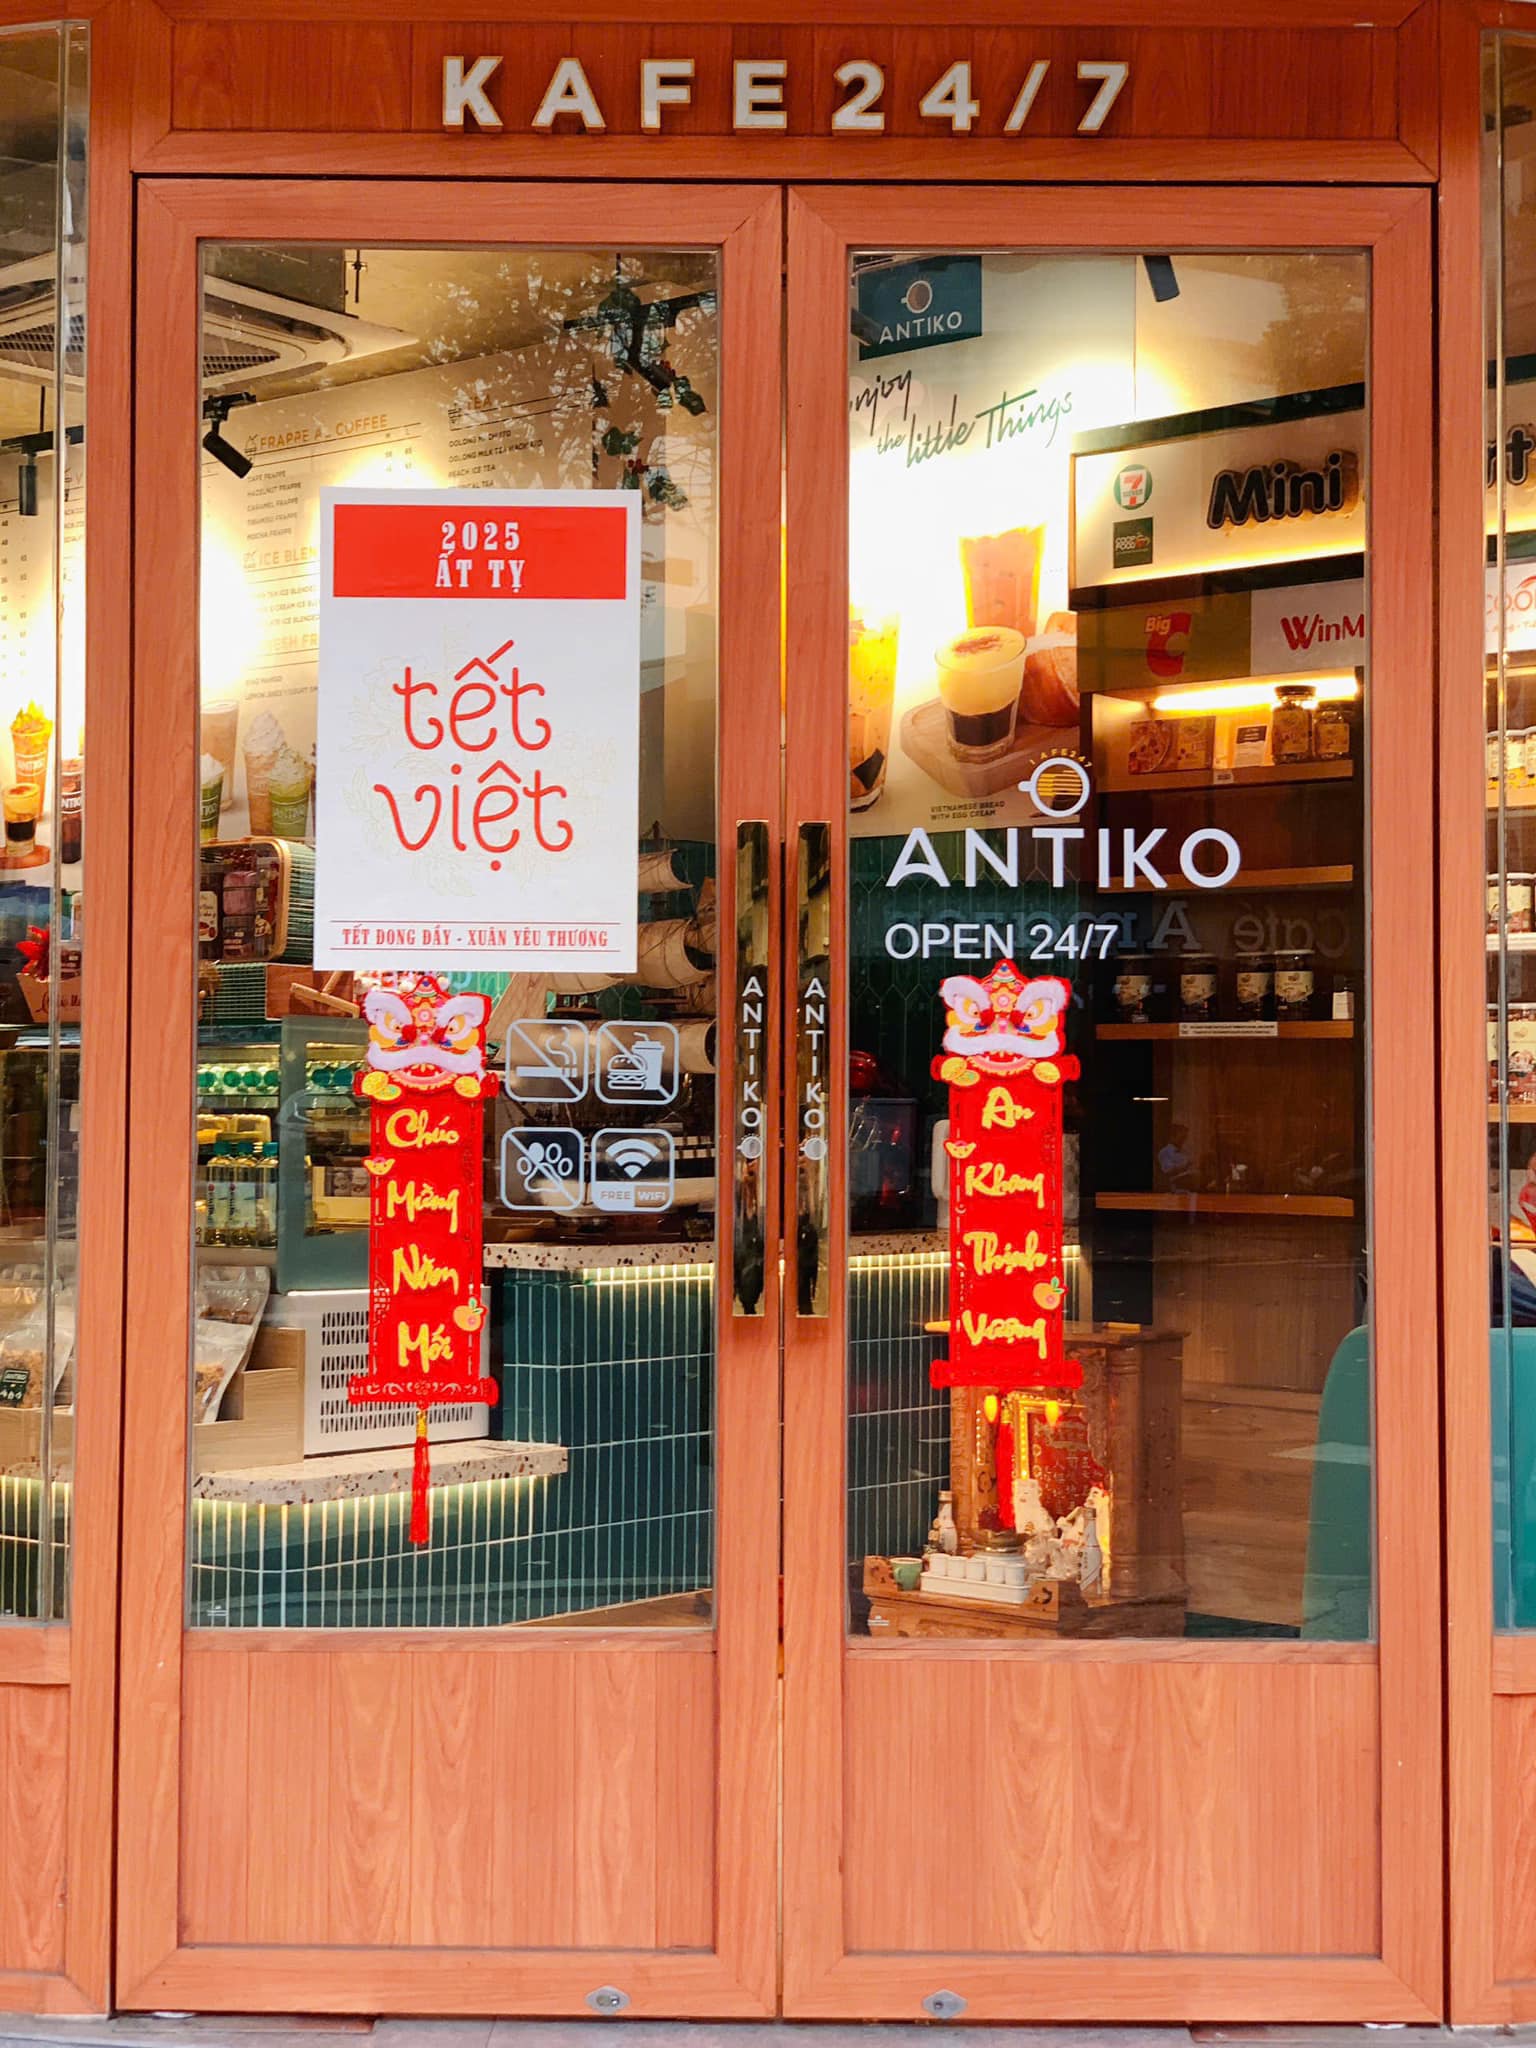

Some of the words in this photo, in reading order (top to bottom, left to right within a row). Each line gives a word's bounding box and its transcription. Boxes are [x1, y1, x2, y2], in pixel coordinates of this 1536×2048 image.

[442, 55, 789, 132] KAFE
[831, 59, 1129, 135] 24/7
[879, 311, 962, 344] ANTIKO
[850, 370, 912, 436] njoy
[260, 428, 309, 449] FRAPPE
[335, 414, 388, 436] COFFEE
[877, 422, 906, 455] the
[906, 393, 975, 468] little
[975, 389, 1072, 448] Things
[1207, 450, 1344, 529] Mini
[441, 520, 521, 551] 2025
[434, 548, 473, 588] ẤT
[487, 559, 526, 593] TỴ
[1145, 615, 1171, 635] Big
[392, 639, 552, 753] tết
[373, 759, 573, 872] việt
[952, 811, 969, 820] EGG
[970, 809, 997, 819] CREAM
[885, 827, 1241, 889] ANTIKO
[342, 923, 370, 946] TẾT
[468, 926, 507, 947] XUÂN
[513, 926, 541, 947] YÊU
[547, 927, 609, 948] THƯƠNG
[885, 922, 1015, 961] OPEN
[1030, 922, 1119, 961] 24/7
[741, 975, 765, 1128] ANTIKO
[803, 976, 827, 1130] ANTIKO
[385, 1108, 460, 1149] Chúc
[981, 1086, 1036, 1130] An
[600, 1190, 632, 1200] FREE
[964, 1161, 1045, 1210] Khang
[392, 1243, 459, 1296] Năm
[963, 1230, 1048, 1276] Thịnh
[397, 1320, 454, 1374] Mới
[962, 1310, 1048, 1360] Vượng
